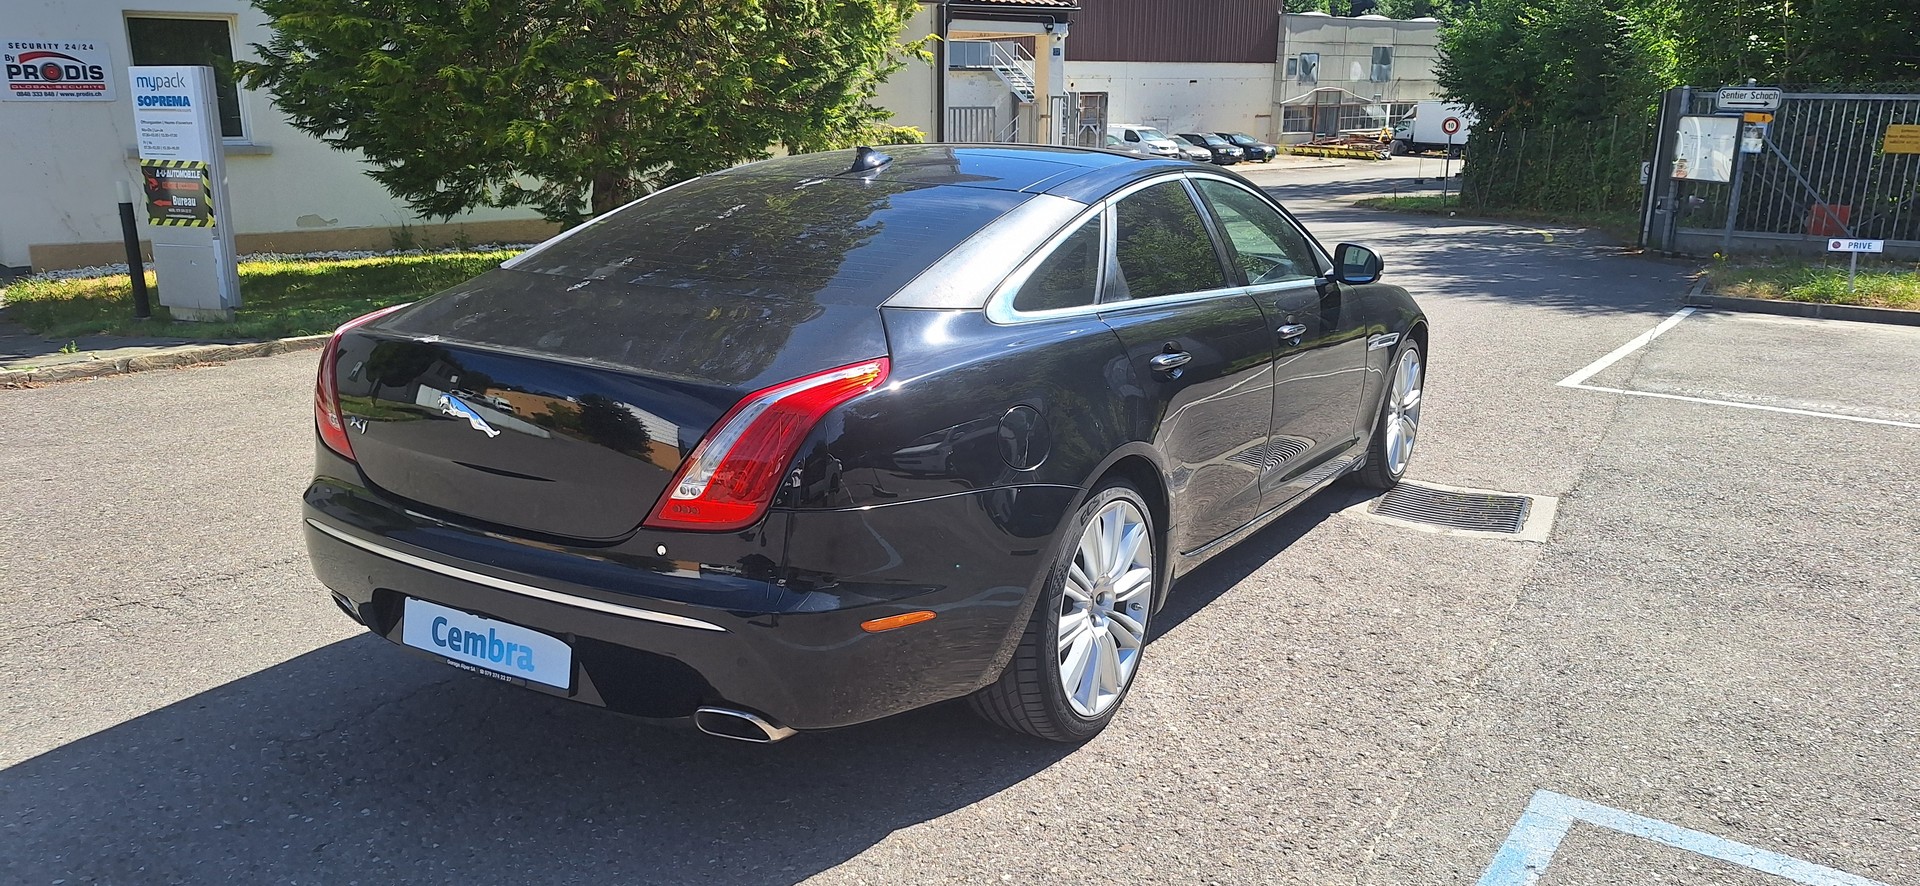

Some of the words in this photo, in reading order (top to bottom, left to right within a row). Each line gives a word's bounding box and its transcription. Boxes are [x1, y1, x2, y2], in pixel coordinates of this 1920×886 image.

[8, 42, 59, 50] SECURITY
[4, 54, 15, 63] By
[6, 62, 104, 81] PRODIS
[136, 72, 186, 91] mypack
[137, 95, 191, 107] SOPREMA
[1721, 91, 1748, 100] Sentier
[1751, 91, 1778, 100] Schoch
[172, 195, 197, 207] Bureau
[1848, 242, 1873, 250] PRIVE
[431, 616, 535, 672] Cembra
